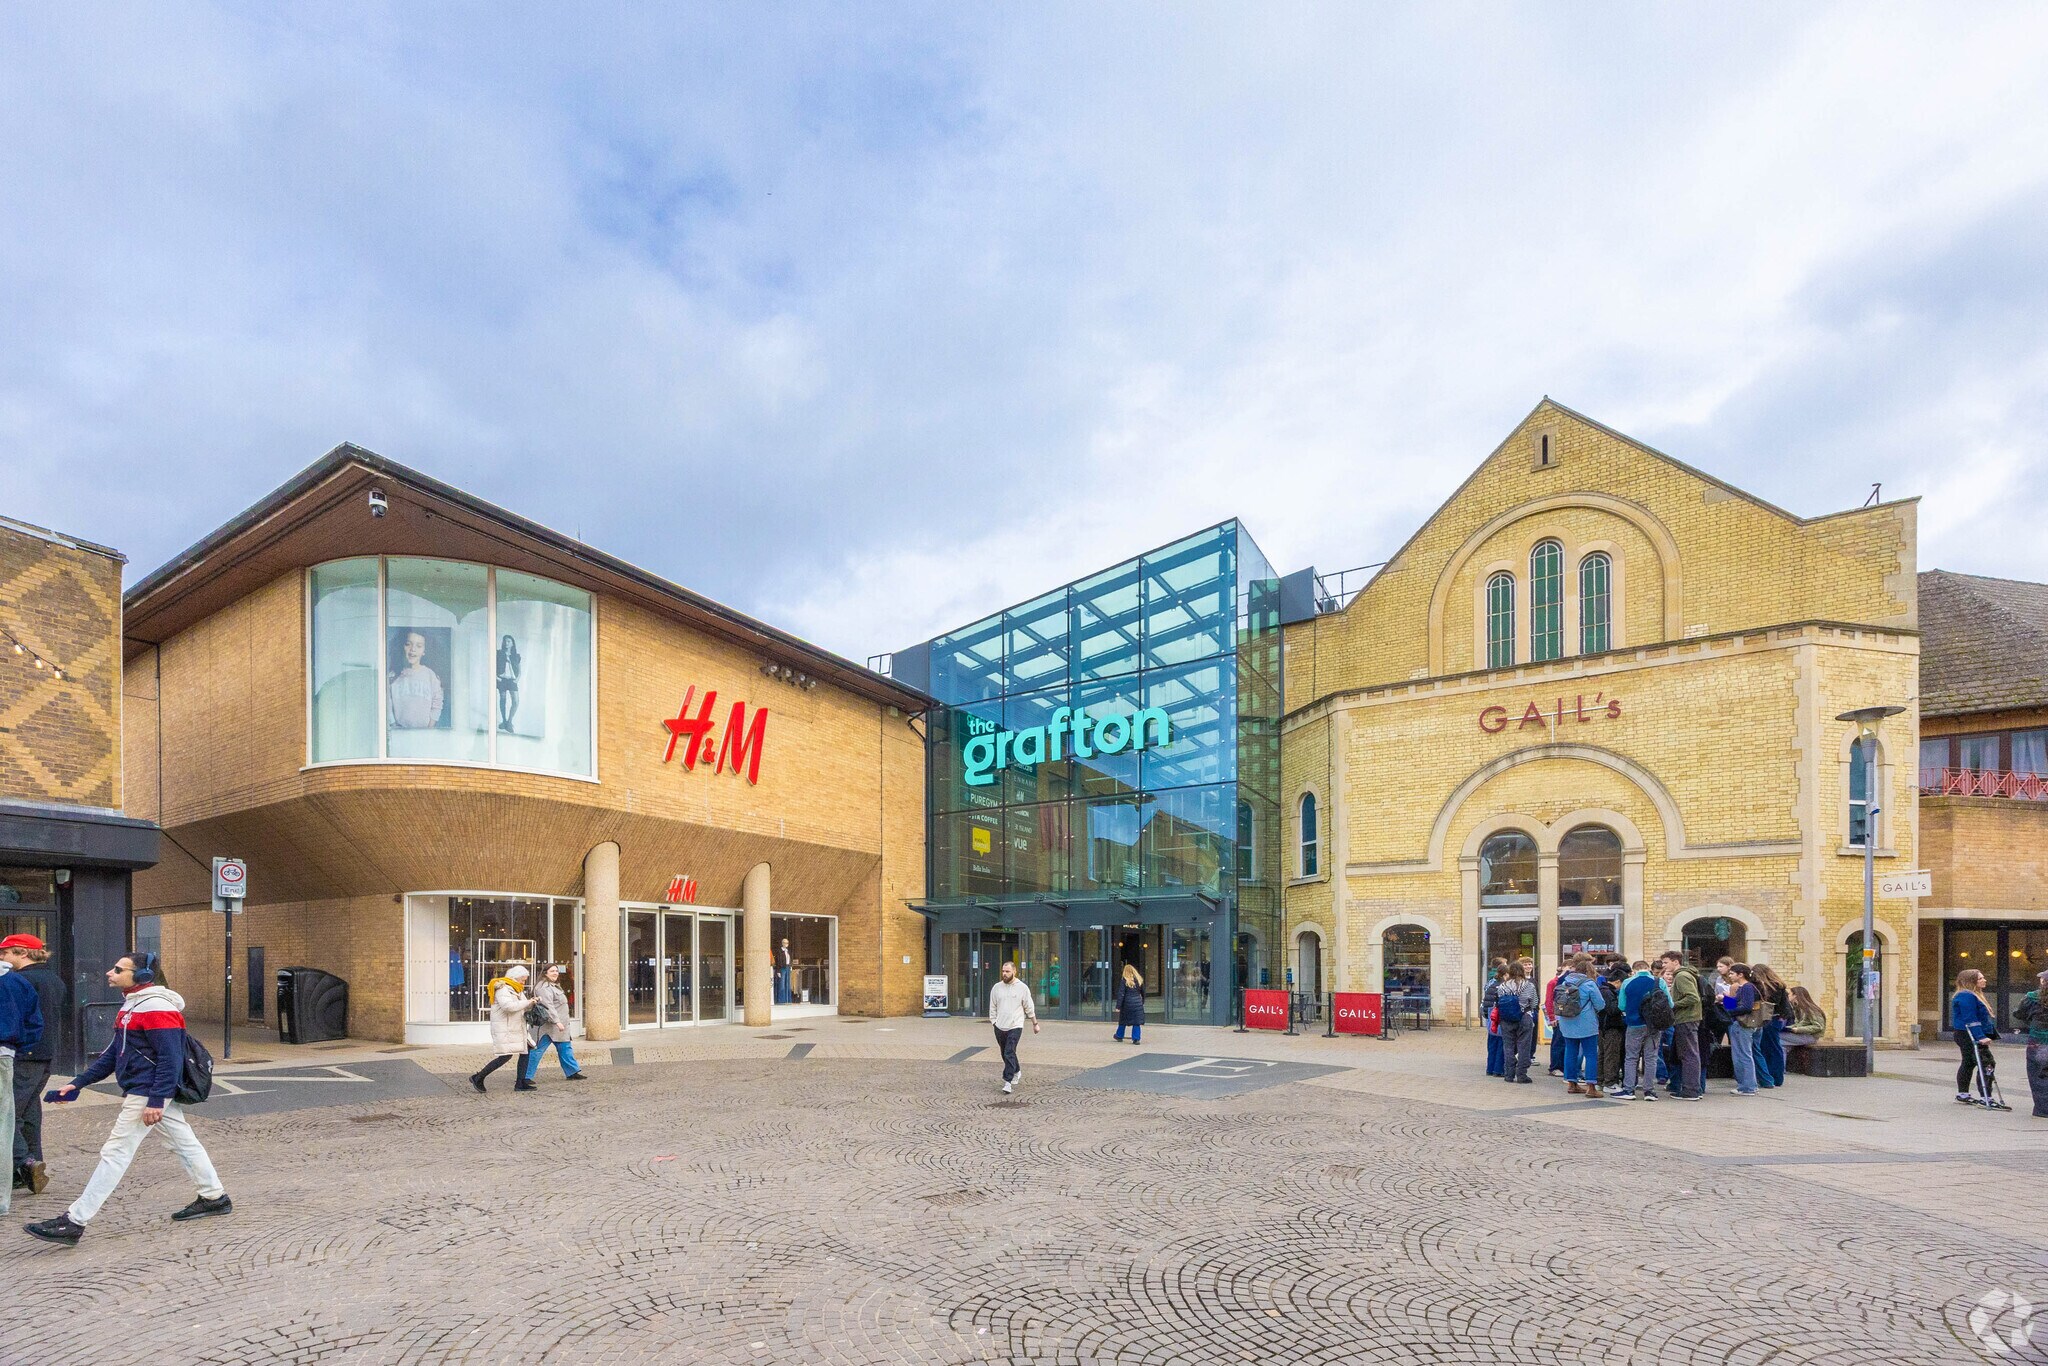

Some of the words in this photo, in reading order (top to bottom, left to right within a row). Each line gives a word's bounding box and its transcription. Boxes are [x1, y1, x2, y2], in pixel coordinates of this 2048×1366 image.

[1479, 691, 1622, 733] GAIL's
[969, 718, 995, 735] the
[661, 684, 769, 787] H&M
[963, 706, 1170, 786] grafton
[970, 793, 998, 808] PUREGYM
[1882, 881, 1927, 893] GAIL's
[1249, 1004, 1284, 1015] GAIL's
[1338, 1008, 1377, 1019] GAIL's
